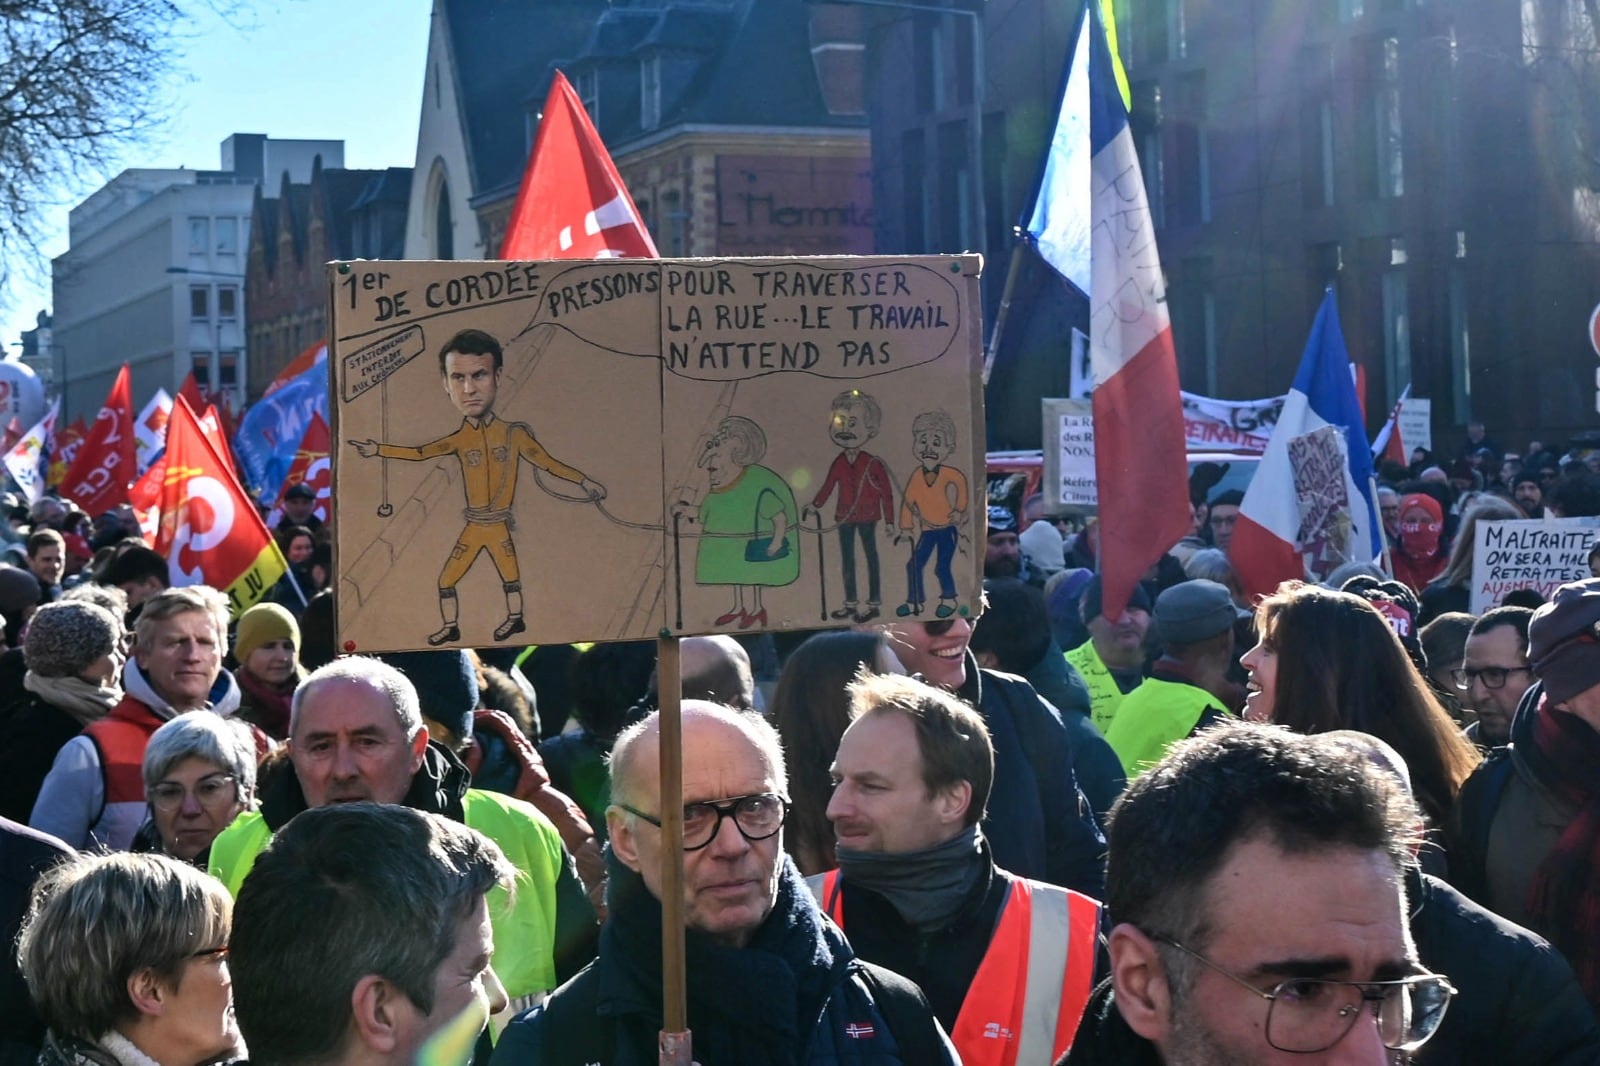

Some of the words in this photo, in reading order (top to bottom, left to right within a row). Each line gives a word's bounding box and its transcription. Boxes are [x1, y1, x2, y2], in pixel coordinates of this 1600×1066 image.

[342, 271, 390, 309] 1er
[374, 290, 411, 322] DE
[426, 262, 541, 308] CORDÉE
[549, 271, 661, 317] PRESSONS
[667, 270, 735, 297] POUR
[752, 270, 911, 298] TRAVERSER
[666, 305, 702, 332] LA
[361, 349, 402, 376] INTERDIT
[669, 335, 820, 370] N'ATTEND
[837, 341, 891, 367] PAS
[1063, 432, 1081, 442] des
[1485, 550, 1513, 567] ON
[1514, 551, 1552, 566] SERA
[1559, 552, 1587, 566] MAL
